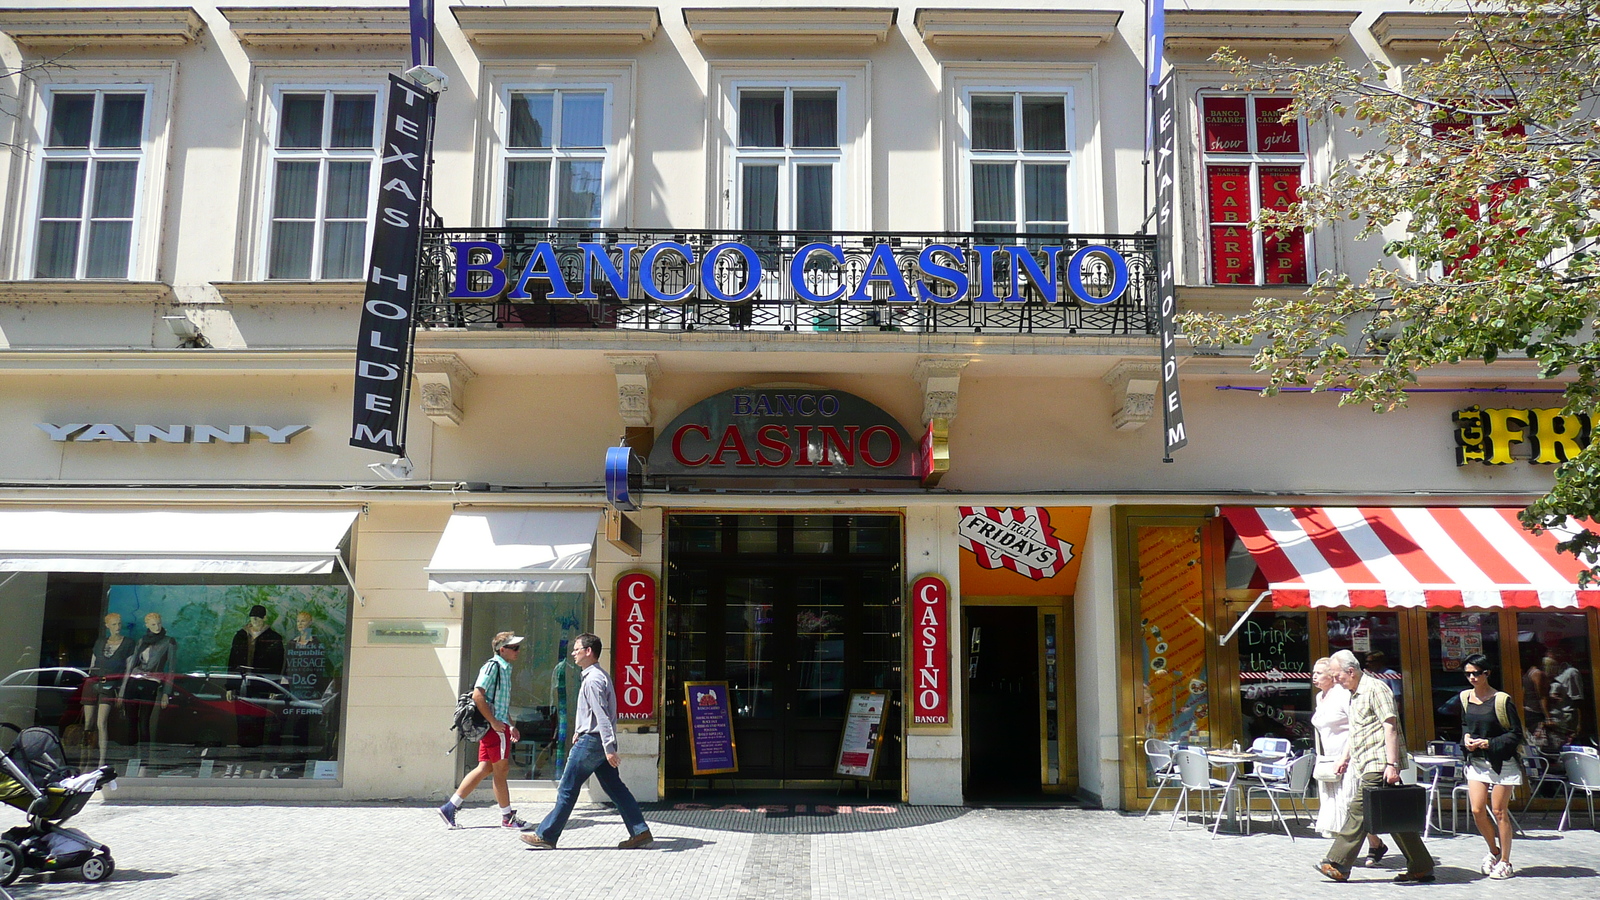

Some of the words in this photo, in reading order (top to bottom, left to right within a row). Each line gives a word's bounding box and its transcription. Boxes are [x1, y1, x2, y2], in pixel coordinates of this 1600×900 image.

[1157, 76, 1172, 225] TEXAS
[1211, 136, 1243, 150] show
[1263, 131, 1292, 151] girls
[383, 83, 425, 228] TEXAS
[1222, 180, 1241, 284] CABARET
[1273, 180, 1293, 284] CARET
[448, 241, 762, 303] BANCO
[791, 242, 1129, 305] CASINO
[732, 394, 840, 417] BANCO
[33, 423, 311, 444] YANNY
[671, 424, 901, 468] CASINO
[966, 516, 1054, 563] FRIDAY'S
[624, 581, 646, 707] CASINO
[1245, 620, 1296, 646] Drink
[919, 584, 940, 710] CASINO
[1269, 641, 1285, 655] of
[286, 657, 326, 667] VERSACE
[1250, 653, 1273, 671] the
[1279, 653, 1304, 673] day
[292, 673, 317, 685] D&G
[915, 715, 945, 723] BANCO
